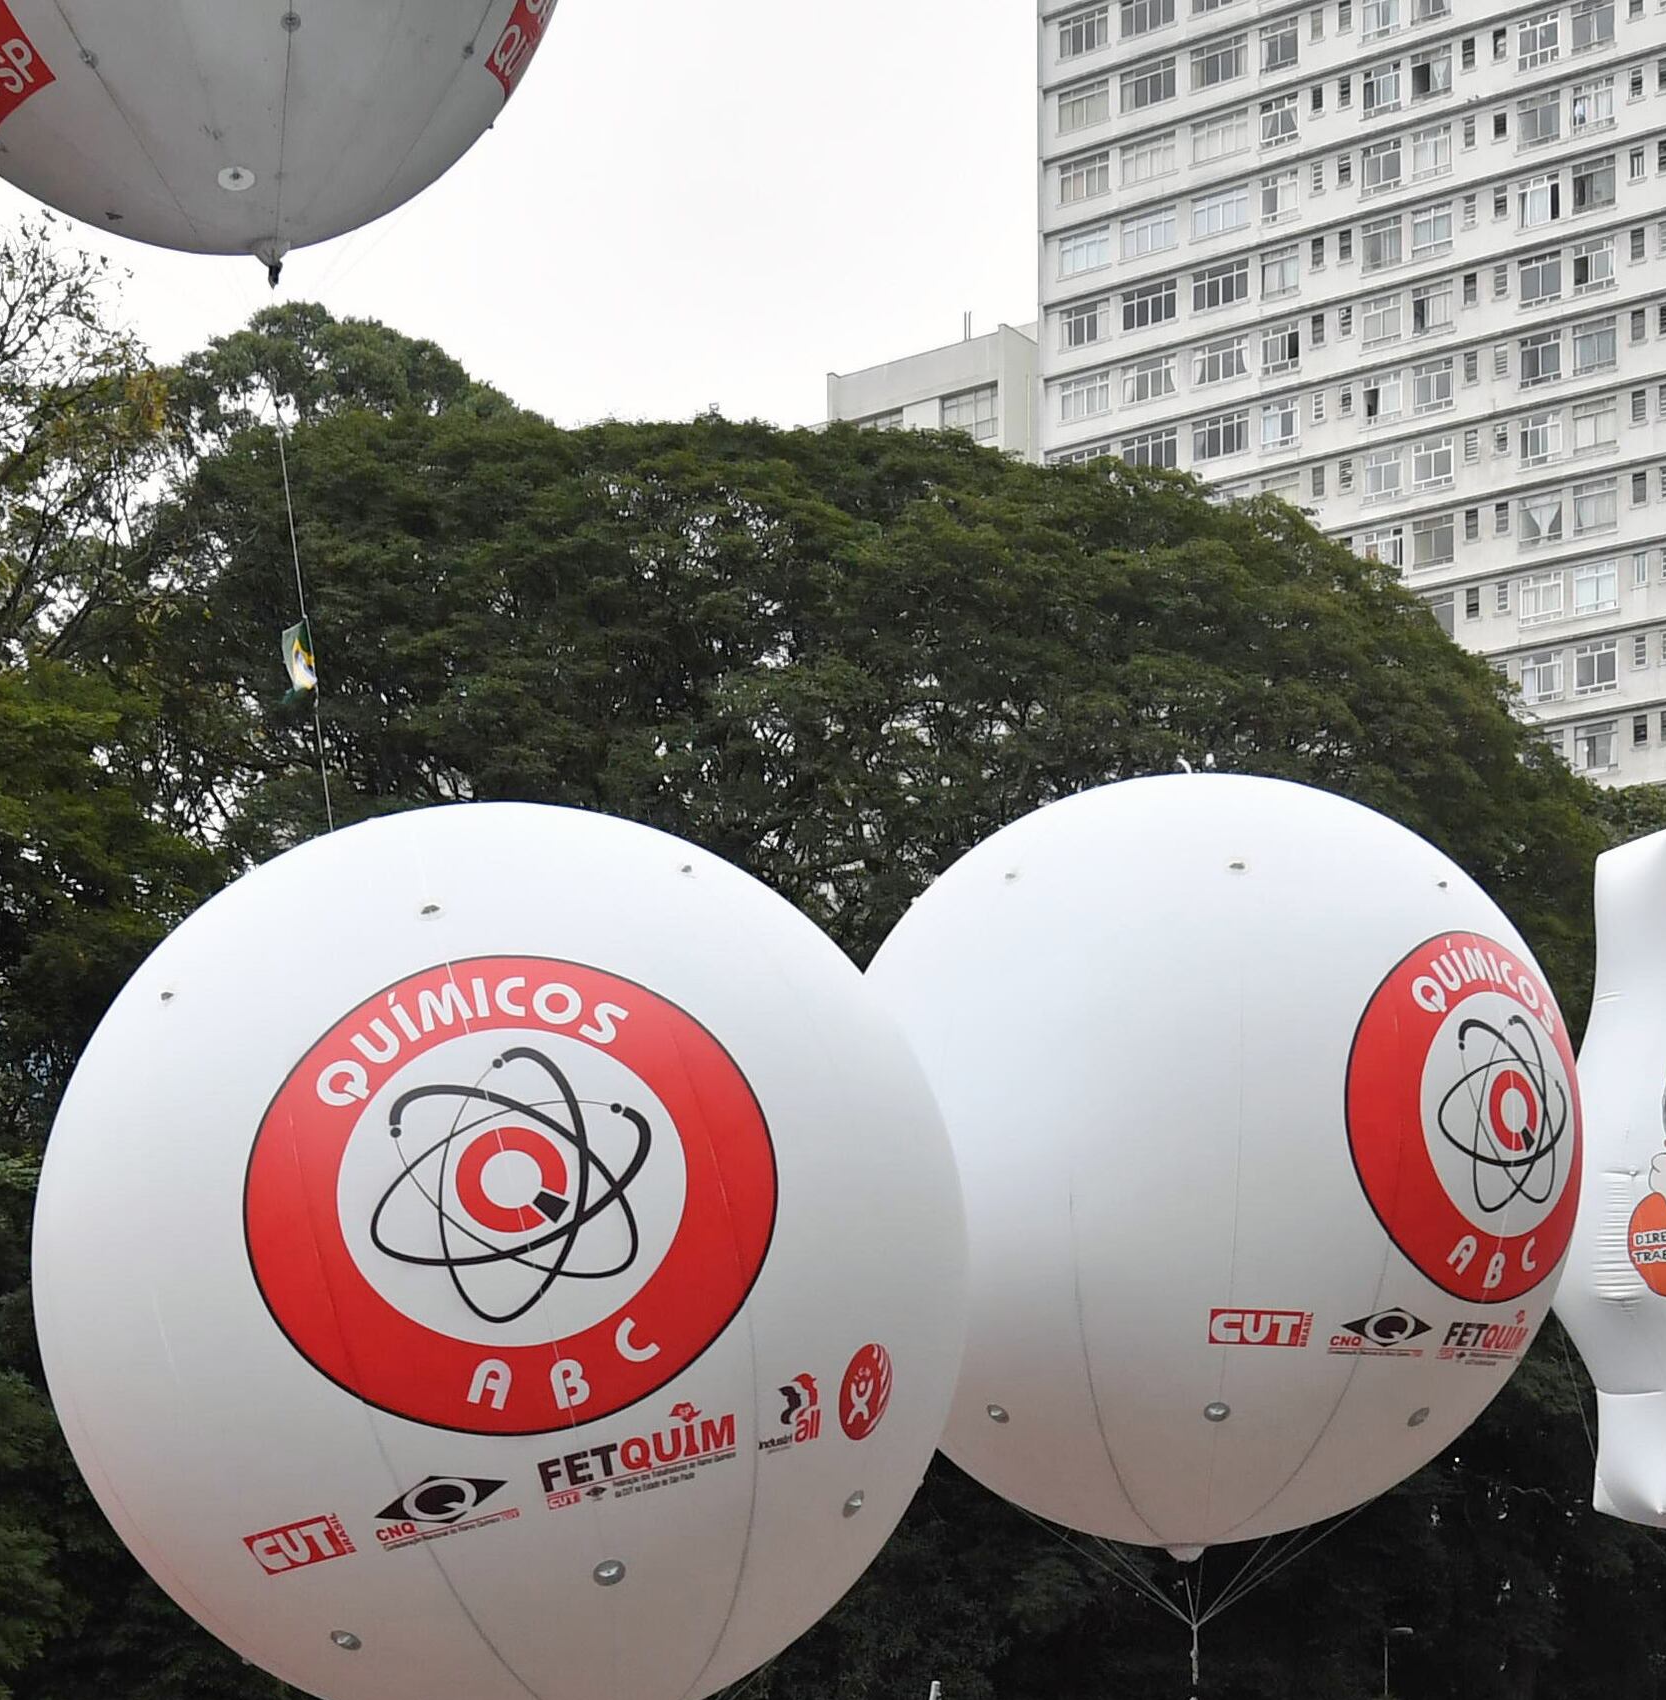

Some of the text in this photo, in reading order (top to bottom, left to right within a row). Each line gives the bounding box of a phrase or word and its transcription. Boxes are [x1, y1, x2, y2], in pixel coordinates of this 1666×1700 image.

[1411, 938, 1555, 1035] QUÍMICOS
[316, 976, 630, 1107] QUÍMICOS
[1210, 1311, 1302, 1344] CUT
[1329, 1335, 1363, 1347] CNQ
[251, 1519, 337, 1572] CUT
[375, 1520, 419, 1543] CNQ
